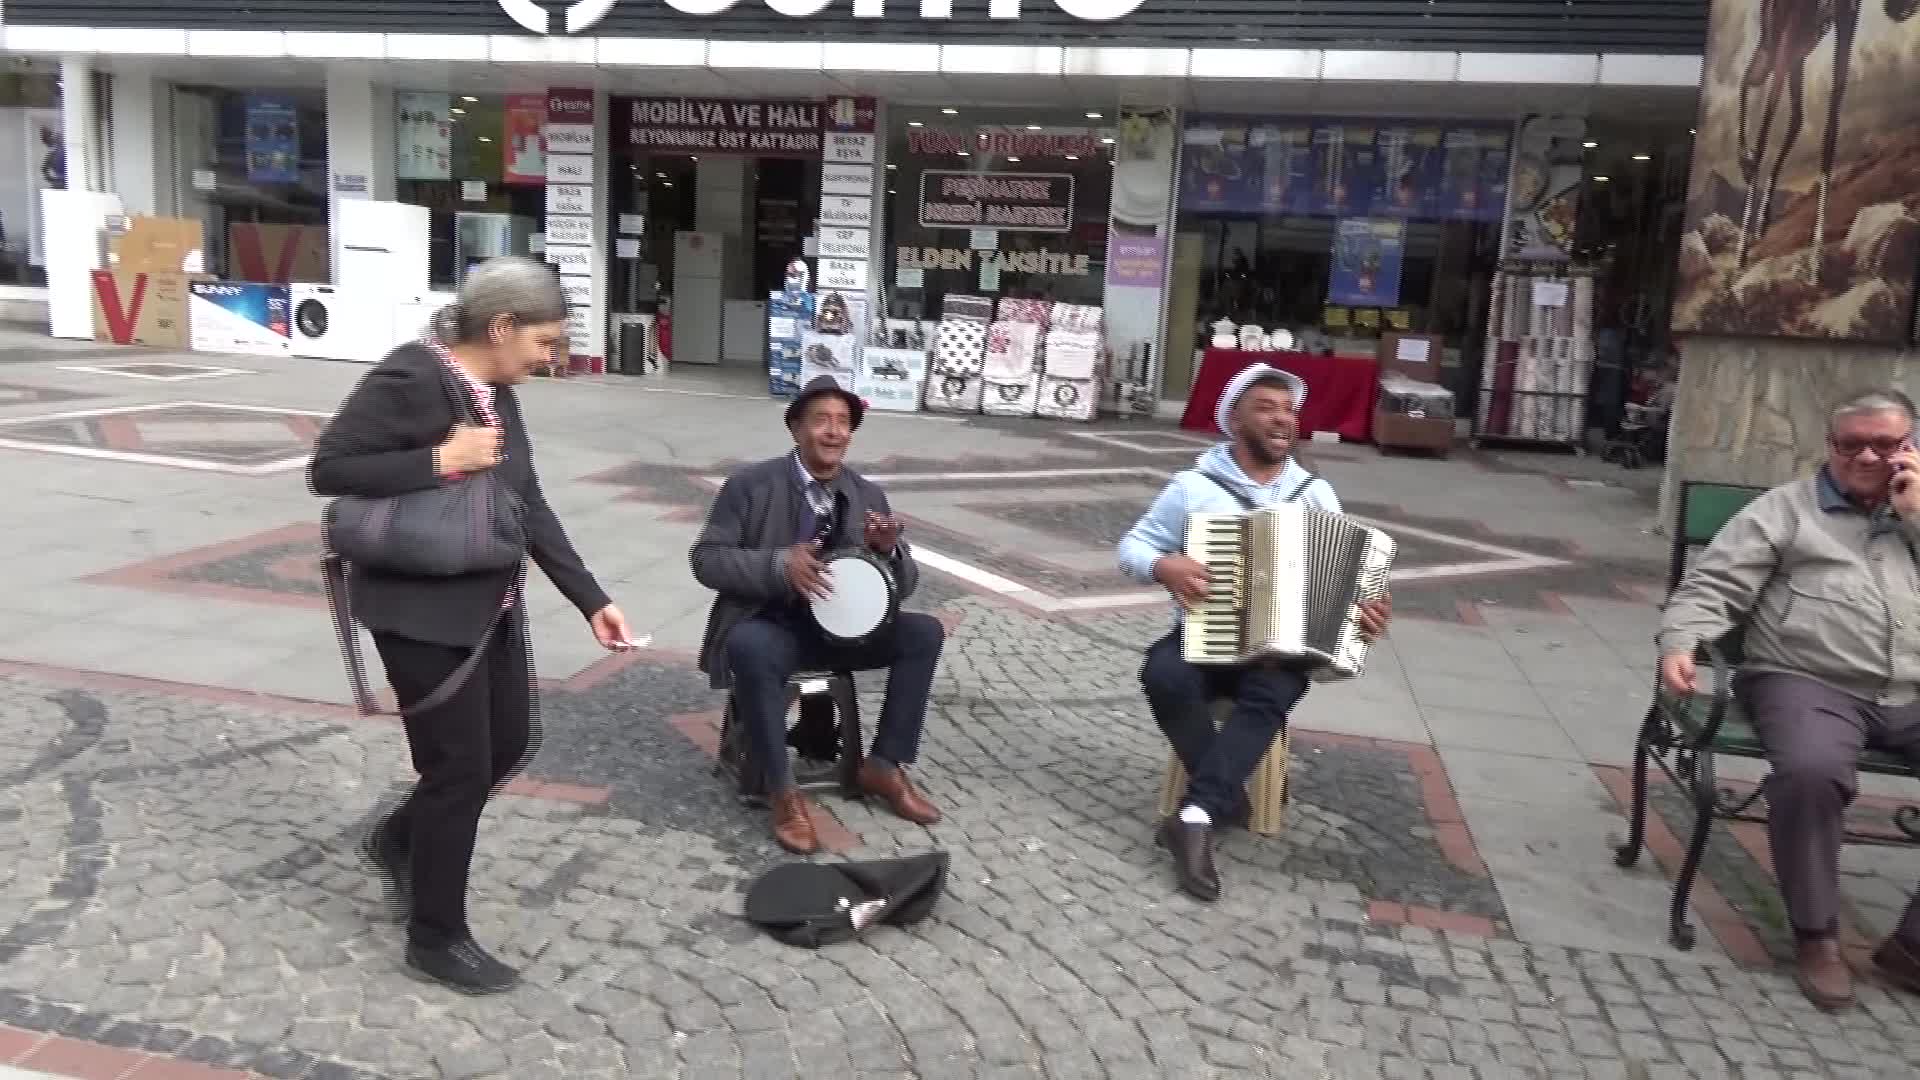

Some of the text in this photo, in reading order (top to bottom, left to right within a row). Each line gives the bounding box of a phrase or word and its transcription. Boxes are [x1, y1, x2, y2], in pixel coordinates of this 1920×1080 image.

[631, 98, 818, 128] MOBİLYA VE HALI
[548, 130, 591, 145] MOBİLYA
[630, 128, 819, 150] REYONUMUZ ÜST KATTADIR
[833, 135, 866, 146] BEYAZ
[908, 129, 962, 155] TÜM
[836, 147, 863, 159] EŞYA
[558, 165, 582, 176] HALI
[942, 175, 1051, 200] PEŞİNATSIZ
[841, 199, 852, 208] TV
[925, 201, 1066, 225] KREDİ KARTSIZ
[836, 230, 854, 240] CEP
[821, 243, 867, 255] TELEFONU
[549, 252, 588, 265] TEKSTİL
[897, 246, 1089, 275] ELDEN TAKSİTLE
[830, 261, 855, 271] BAZA
[829, 276, 856, 286] YATAK
[193, 284, 243, 297] SUNNY
